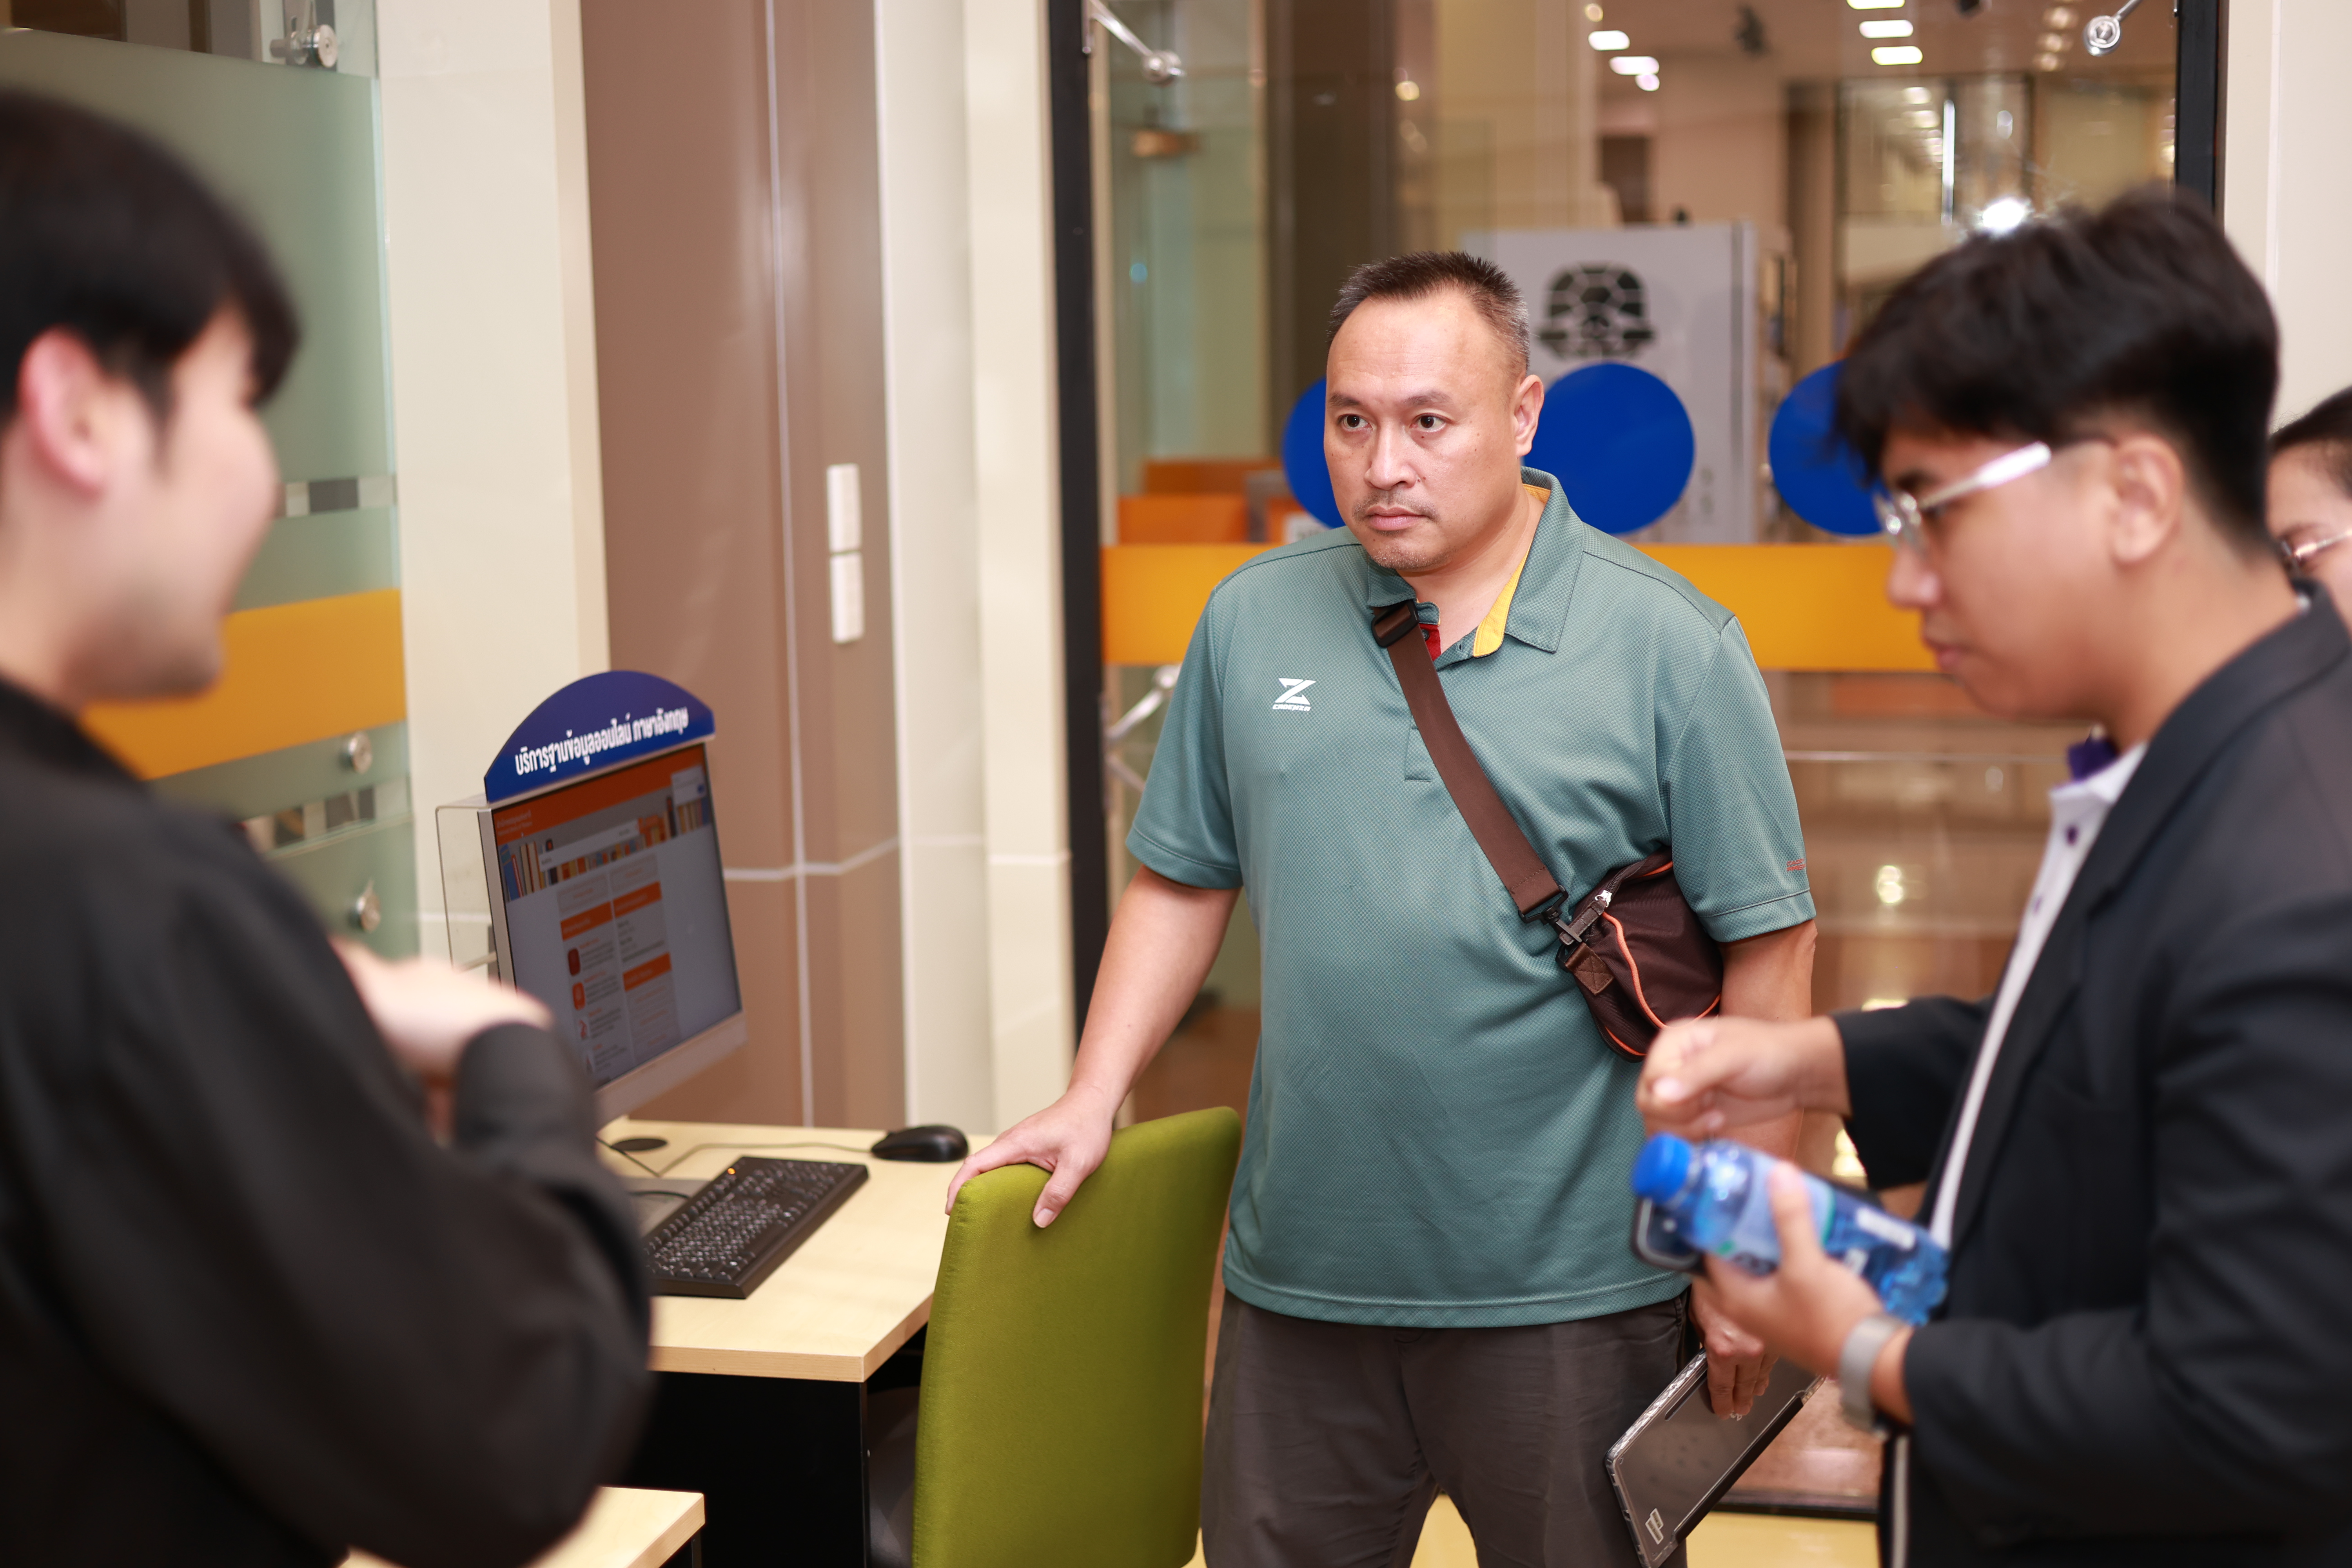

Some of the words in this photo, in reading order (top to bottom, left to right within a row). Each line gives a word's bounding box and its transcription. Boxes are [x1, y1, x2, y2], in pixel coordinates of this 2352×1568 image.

[1272, 704, 1311, 712] CADENZA
[515, 713, 632, 776] บริการฐานข้อมูลออนไลน์
[632, 707, 689, 742] ภาษาอังกฤษ
